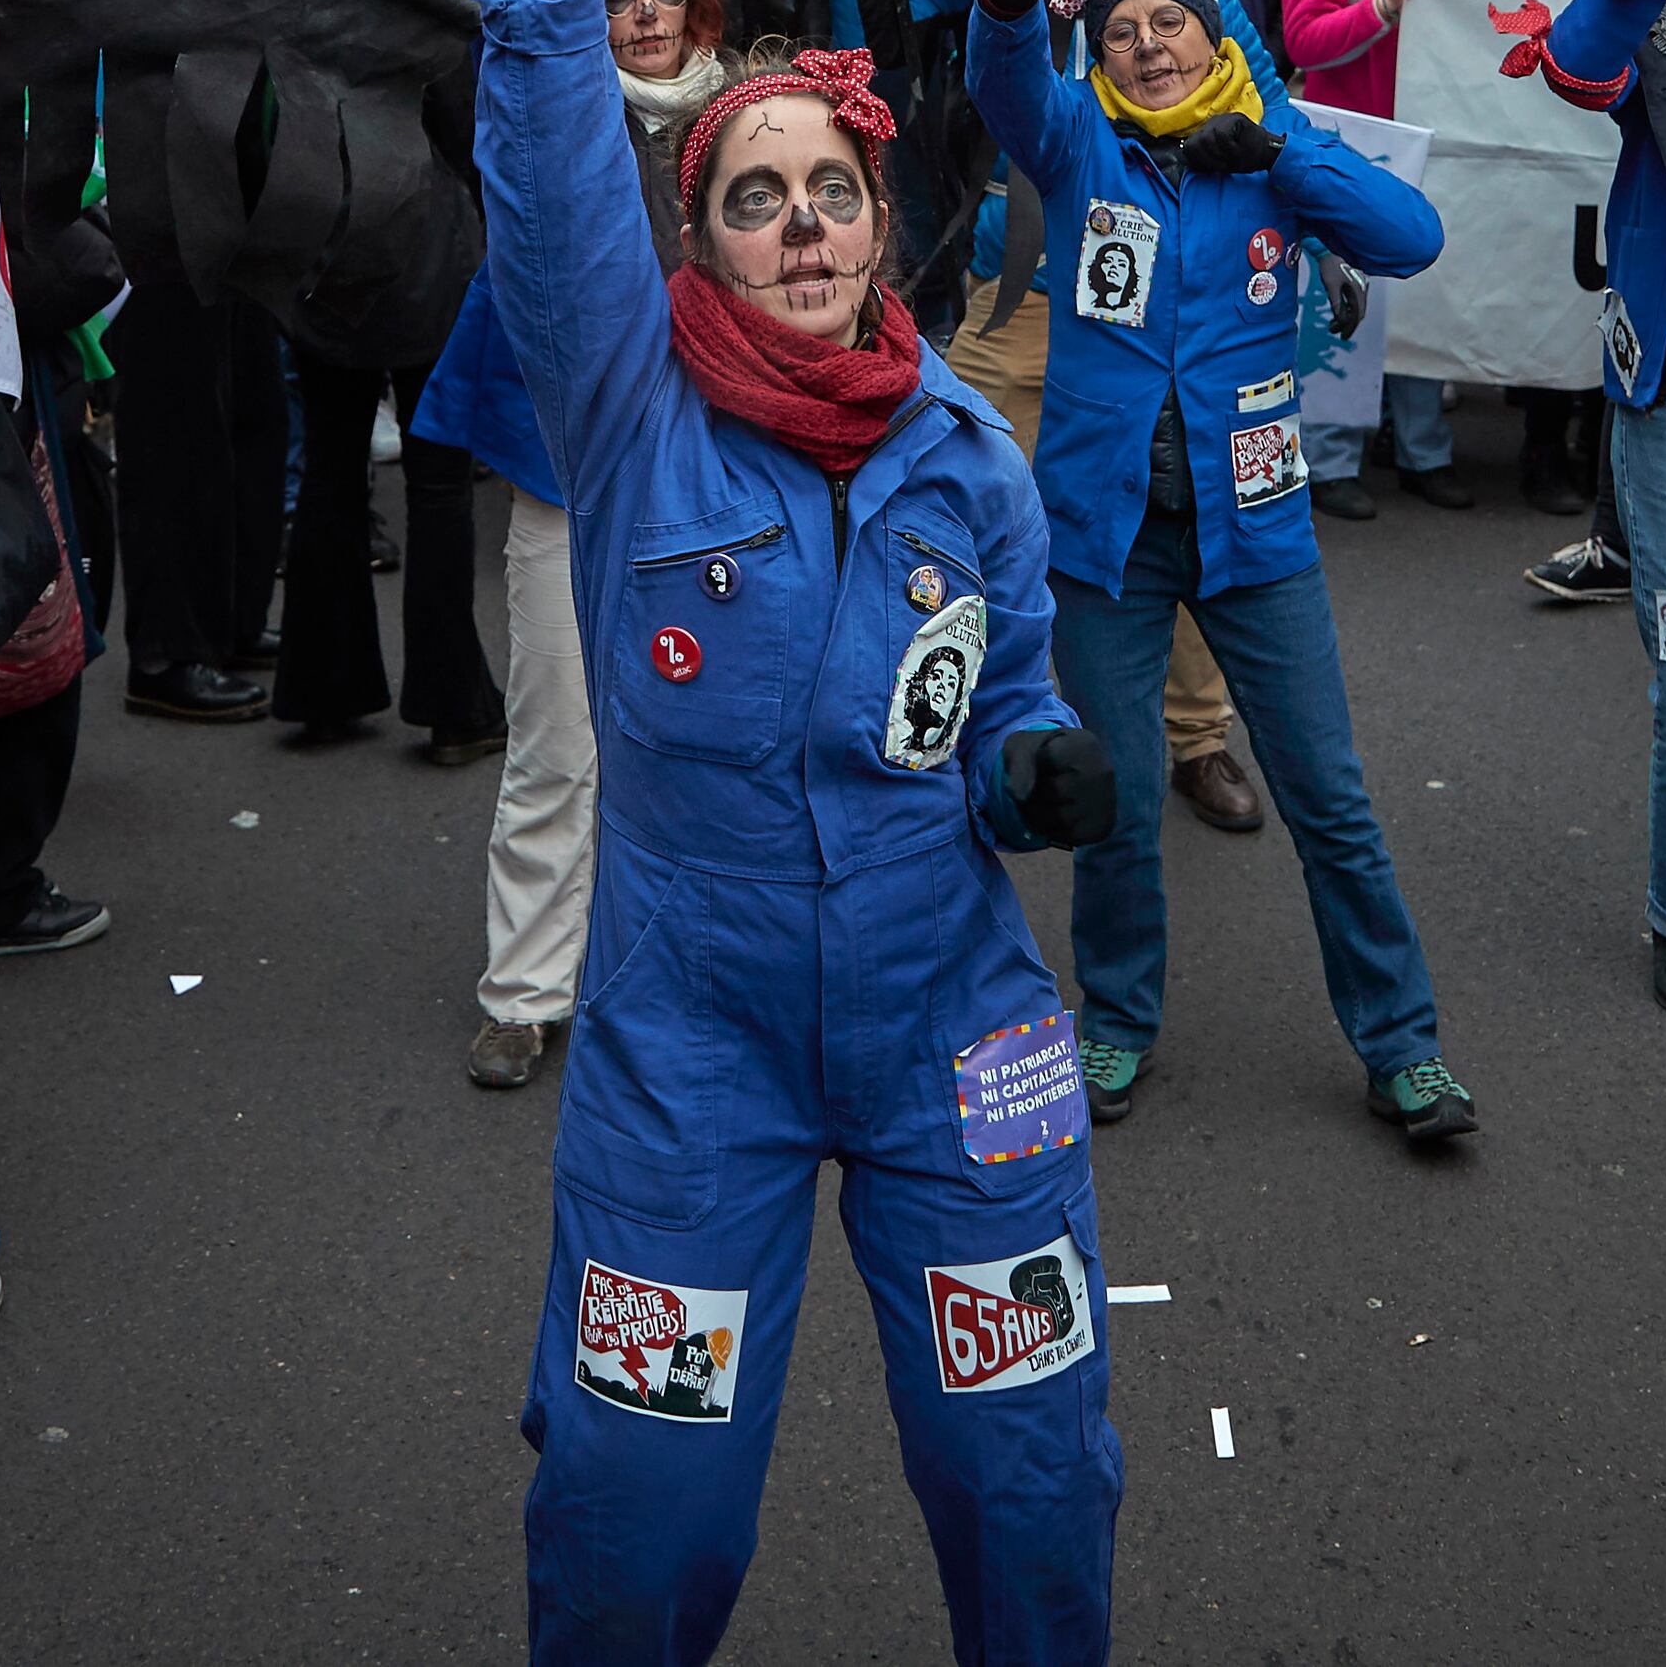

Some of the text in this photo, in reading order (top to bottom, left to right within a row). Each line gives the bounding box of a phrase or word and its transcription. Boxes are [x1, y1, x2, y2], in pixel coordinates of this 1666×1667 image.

[1111, 228, 1155, 243] OLUTION
[979, 1040, 1071, 1085] NI PATRIARCAT,
[980, 1058, 1077, 1105] NI CAPITALISME,
[986, 1107, 1005, 1123] NI
[590, 1273, 633, 1297] PAS DE
[686, 1345, 710, 1366] POT
[669, 1367, 710, 1391] DÉPART
